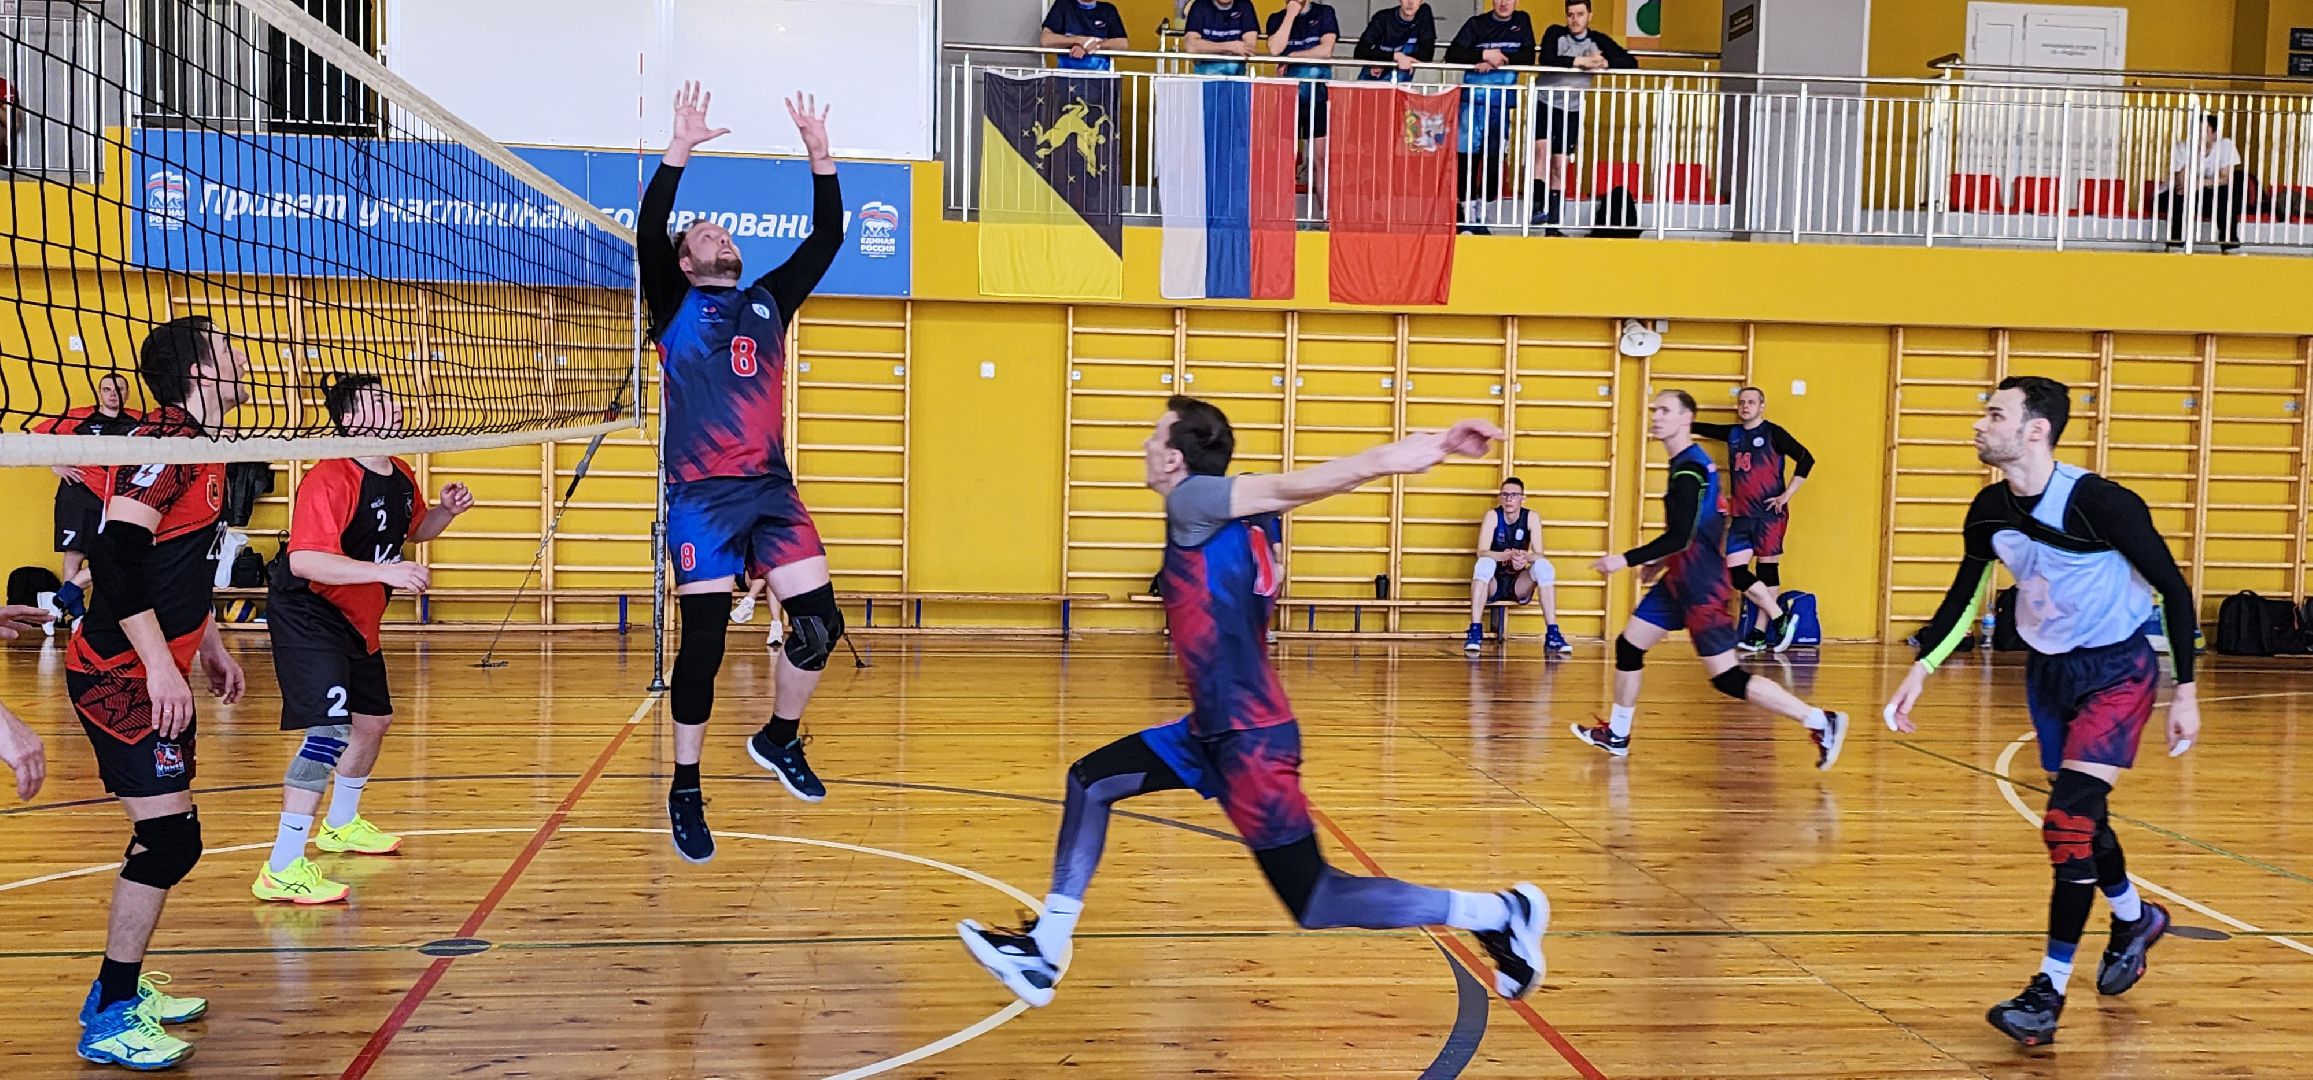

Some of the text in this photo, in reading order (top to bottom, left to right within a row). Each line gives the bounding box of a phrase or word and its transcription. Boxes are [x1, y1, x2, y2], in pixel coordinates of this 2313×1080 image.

[199, 182, 346, 221] Привет
[860, 237, 896, 246] ЕДИНАЯ
[860, 244, 896, 253] РОССИЯ
[730, 335, 757, 377] 8
[376, 508, 387, 532] 2
[62, 529, 76, 546] 7
[680, 542, 696, 572] 8
[326, 685, 349, 717] 2
